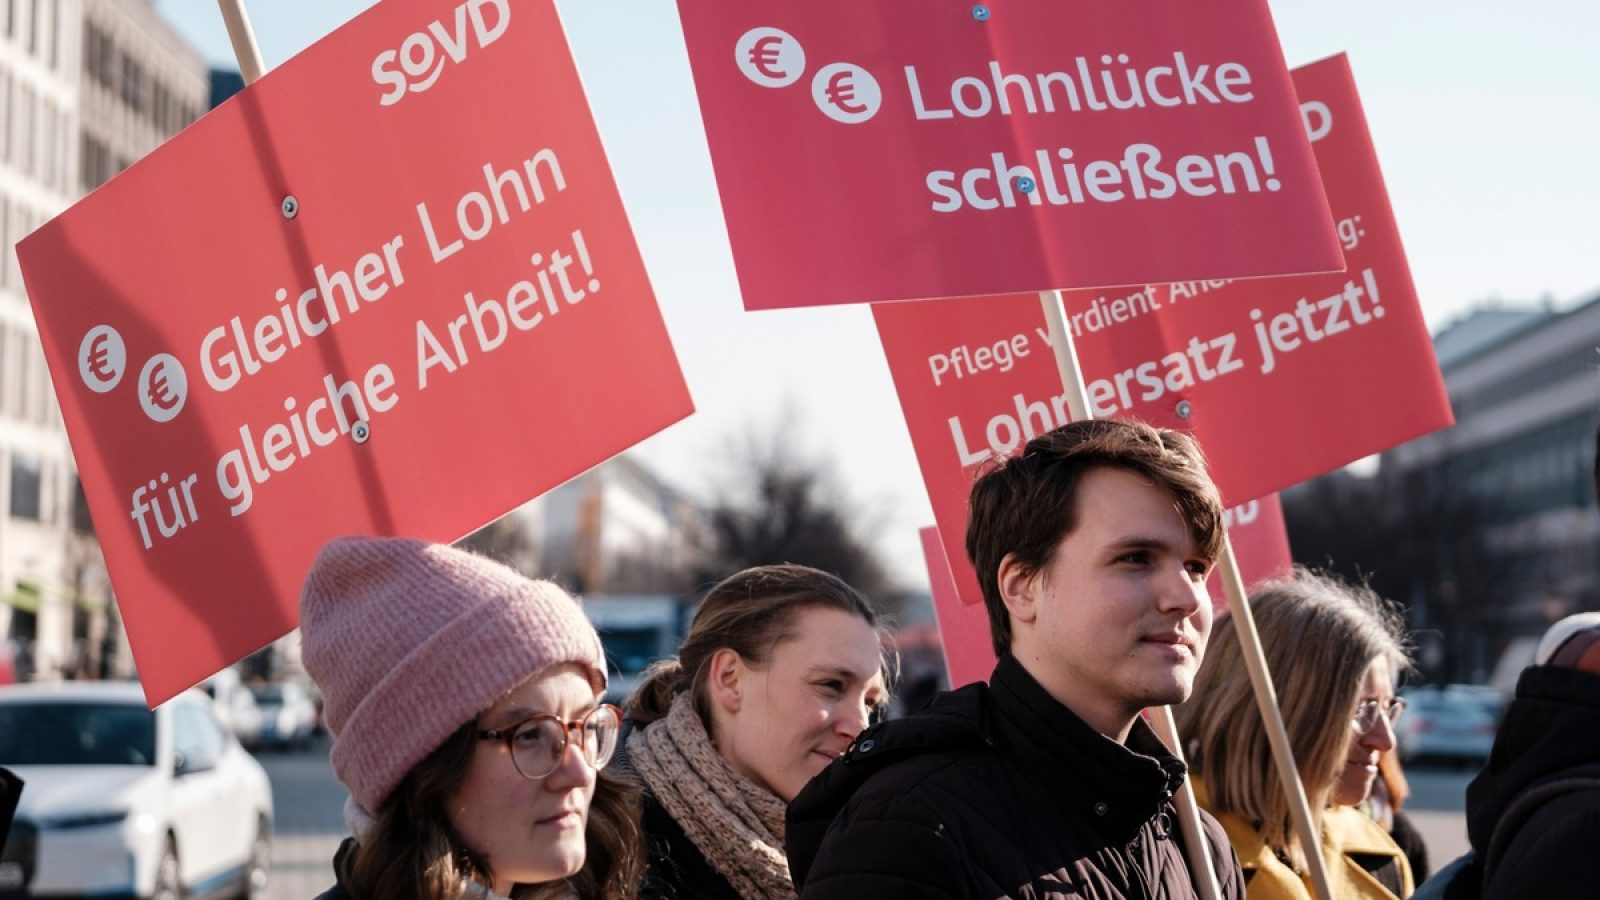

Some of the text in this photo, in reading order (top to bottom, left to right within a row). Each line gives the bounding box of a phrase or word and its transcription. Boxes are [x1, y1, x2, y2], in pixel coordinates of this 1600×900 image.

[904, 51, 1254, 121] Lohnlücke
[925, 135, 1281, 213] schließen!
[200, 147, 567, 393] Gleicher Lohn
[1249, 267, 1385, 375] jetzt!
[928, 333, 1030, 387] Pflege
[1035, 284, 1161, 348] vrdient
[130, 229, 601, 550] für gleiche Arbeit!
